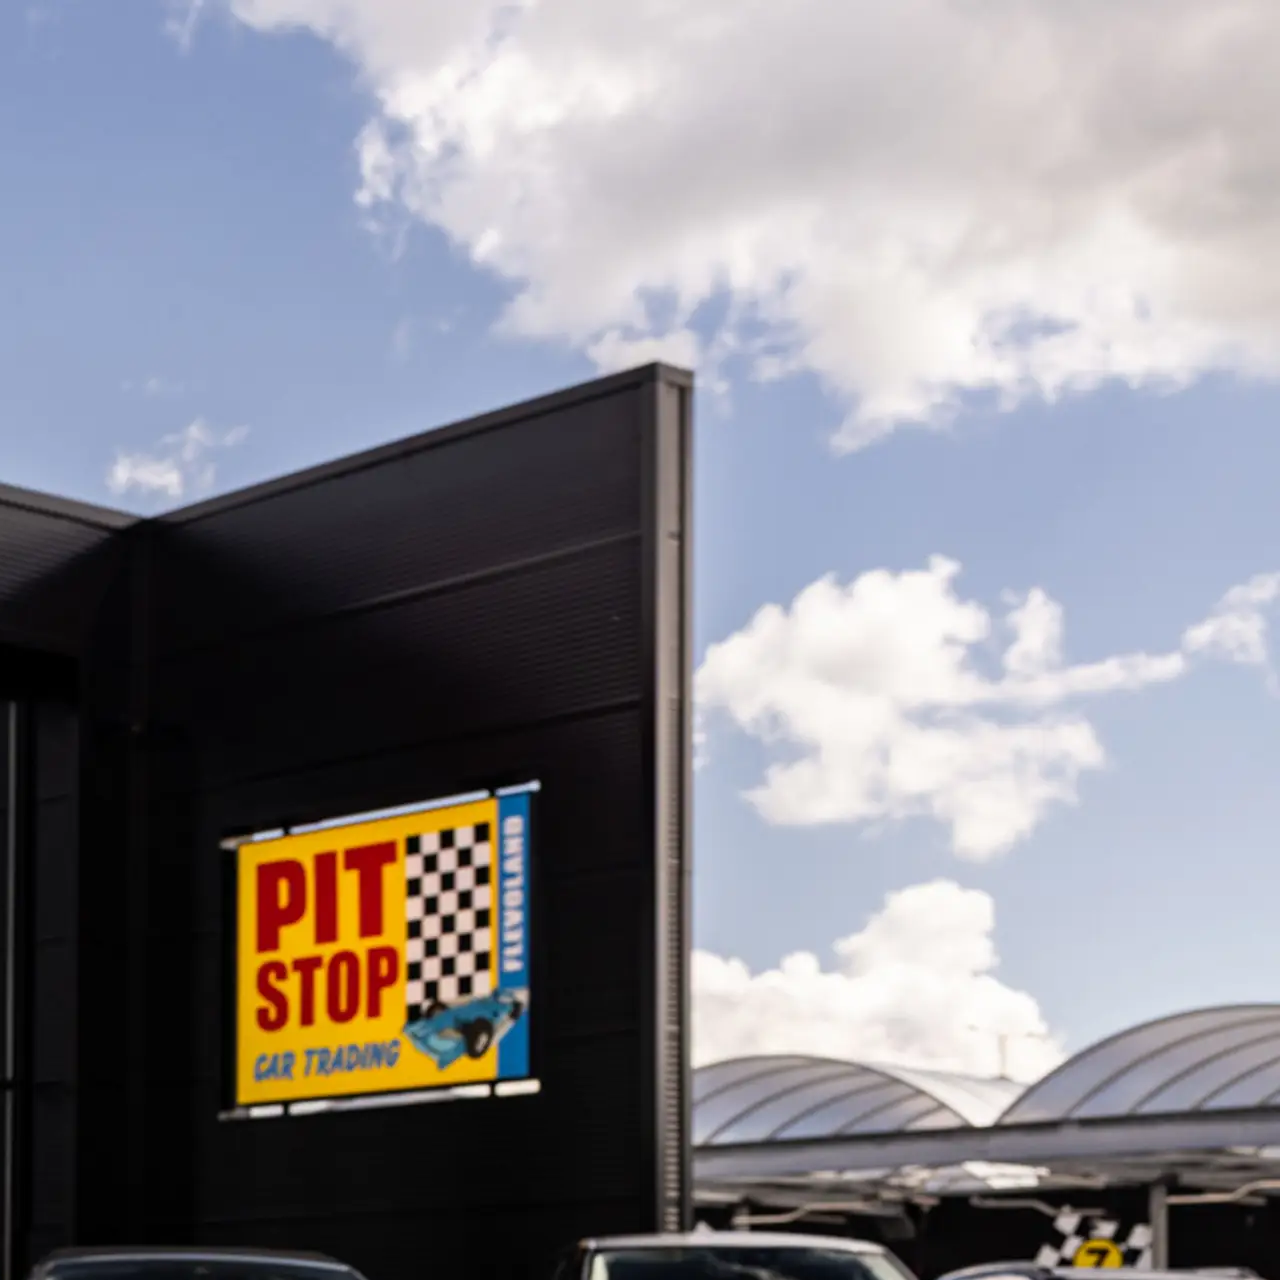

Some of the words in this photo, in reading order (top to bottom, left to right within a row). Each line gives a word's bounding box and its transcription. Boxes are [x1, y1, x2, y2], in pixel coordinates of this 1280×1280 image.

[255, 840, 398, 954] PIT
[255, 945, 399, 1033] STOP
[252, 1050, 297, 1082] CAR
[302, 1039, 402, 1076] TRADING
